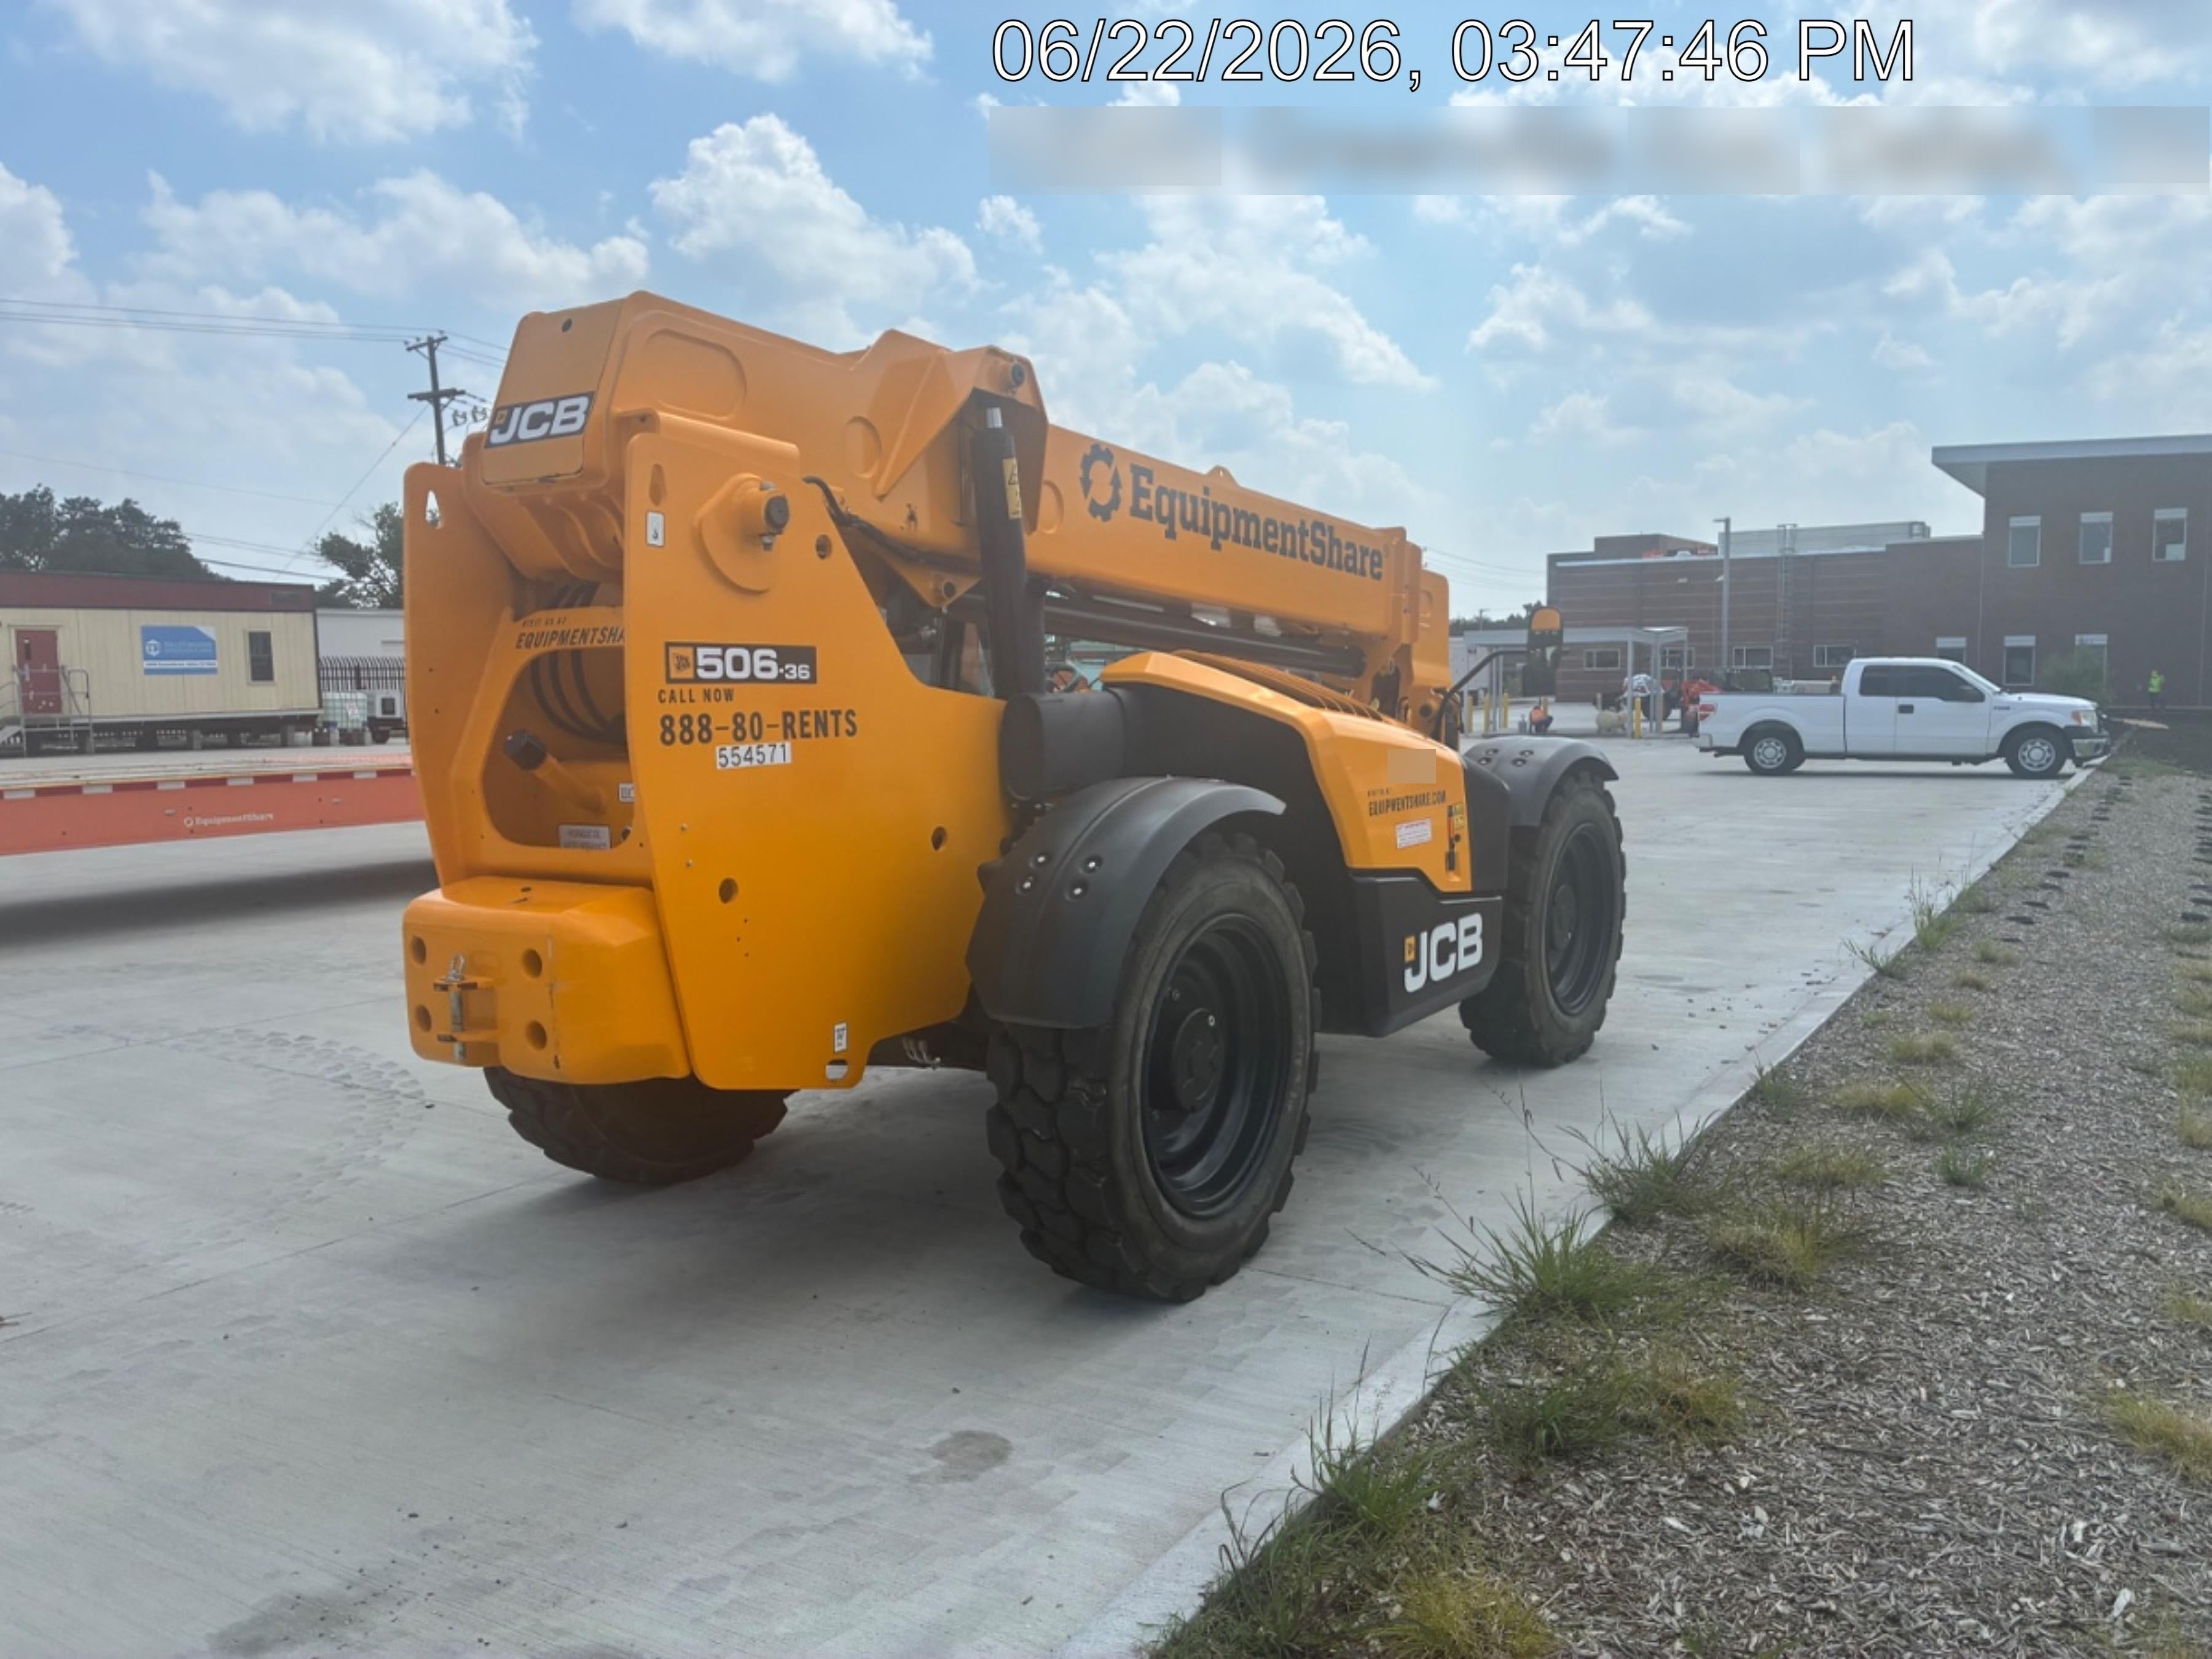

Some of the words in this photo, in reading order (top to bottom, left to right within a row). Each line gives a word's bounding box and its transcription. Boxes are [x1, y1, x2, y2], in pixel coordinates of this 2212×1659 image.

[490, 396, 589, 444] JCB
[1129, 463, 1384, 581] EquipmentShare
[657, 689, 696, 704] CALL
[702, 688, 735, 702] NOW
[659, 708, 858, 747] 888-80-RENTS
[718, 743, 787, 768] 554571
[1404, 912, 1483, 993] JCB
